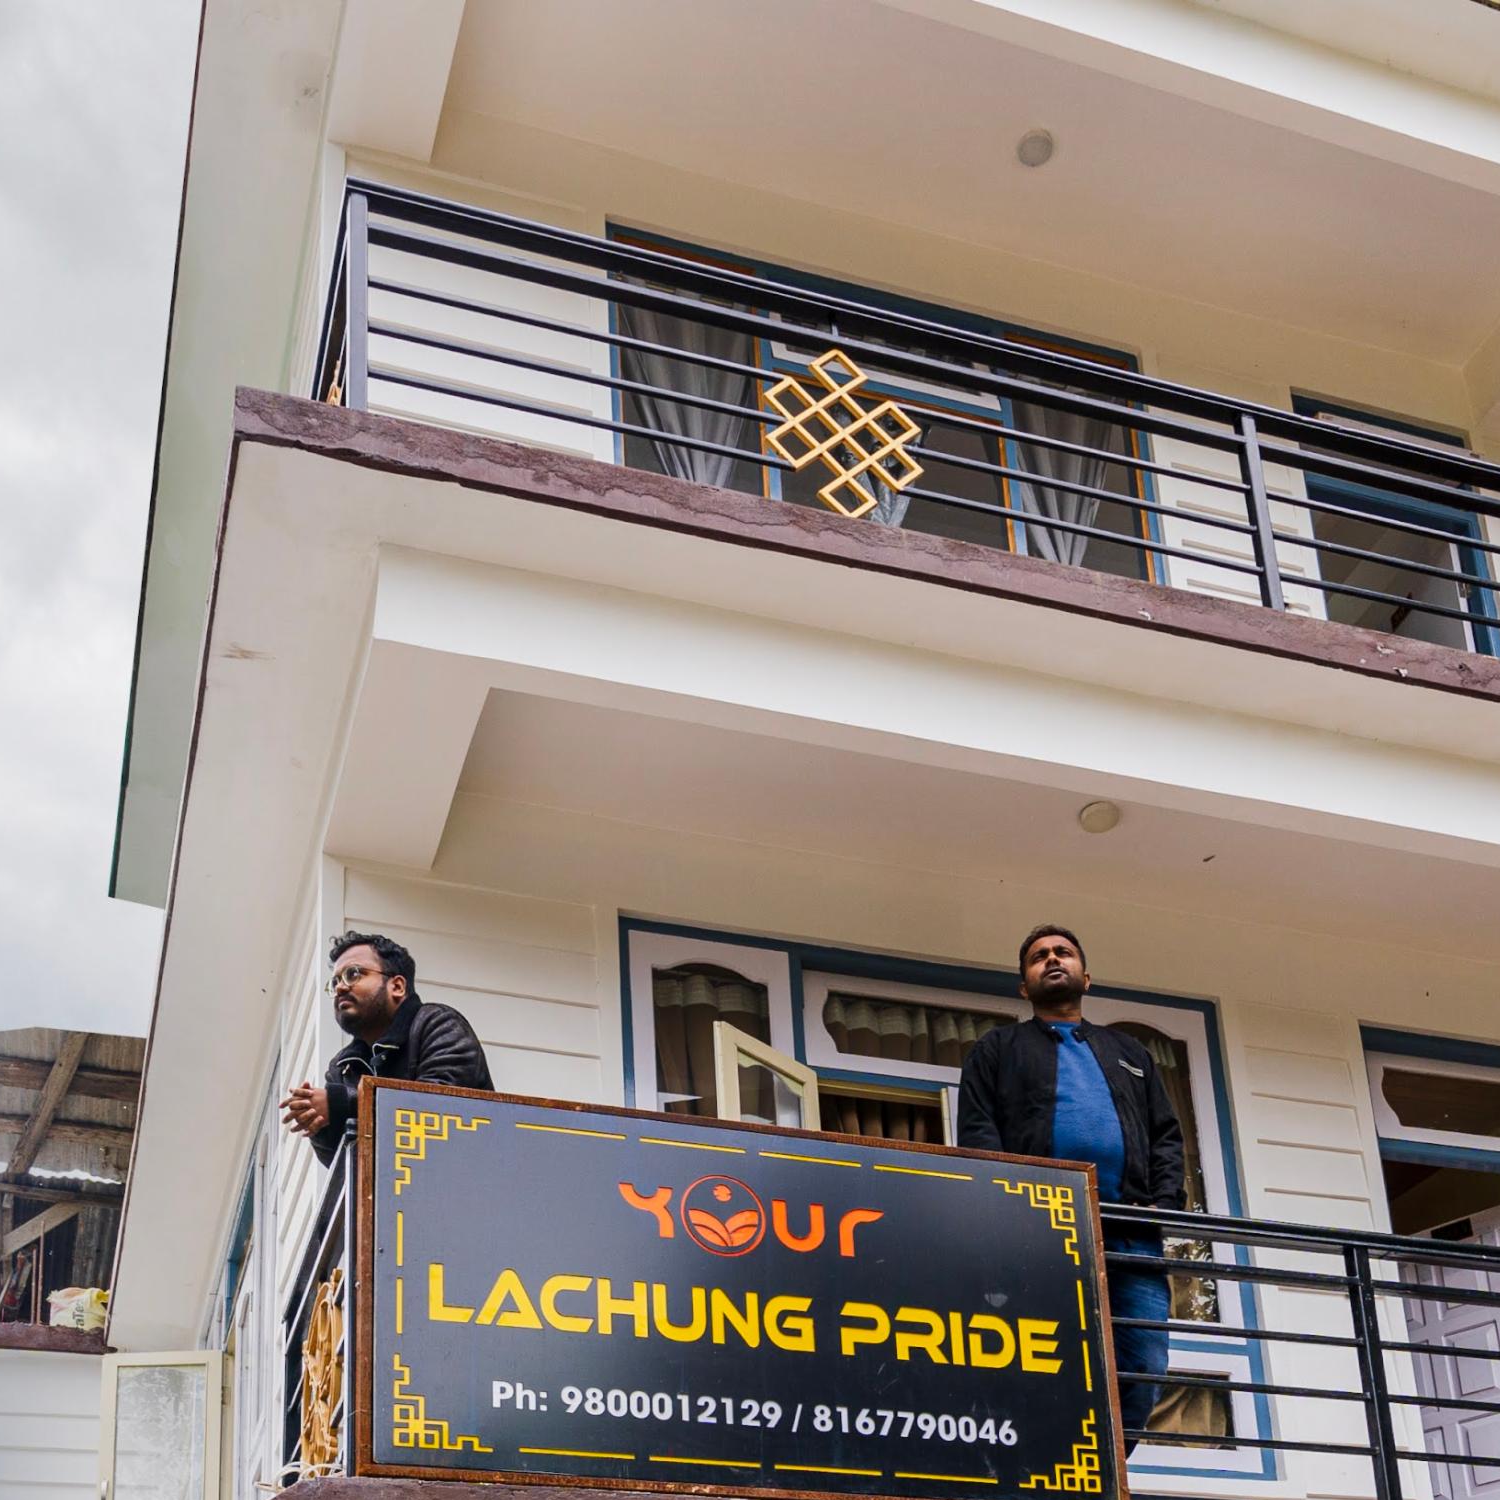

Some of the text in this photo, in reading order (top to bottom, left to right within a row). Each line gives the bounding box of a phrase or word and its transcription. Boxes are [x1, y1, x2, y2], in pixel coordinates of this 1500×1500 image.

[428, 1263, 1063, 1374] LACHUNG PRIDE
[491, 1380, 1019, 1446] Ph: 9800012129 / 8167790046
